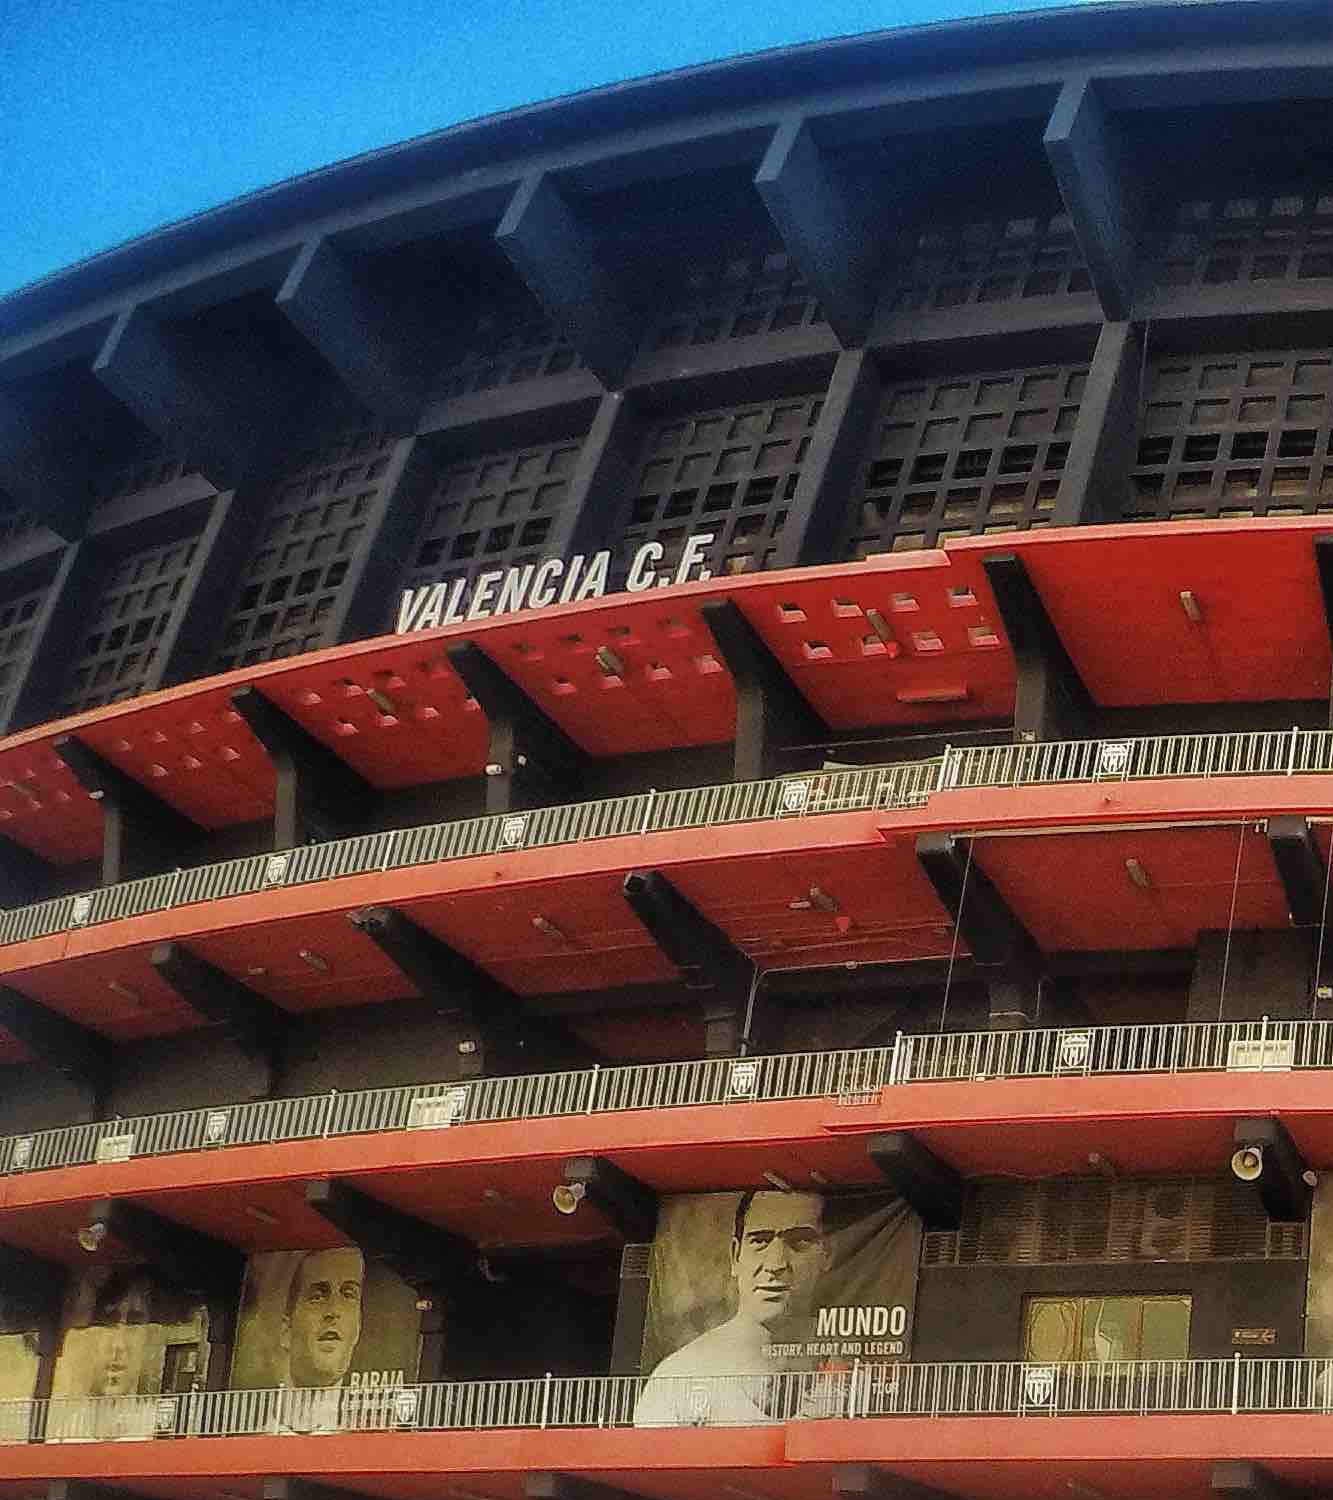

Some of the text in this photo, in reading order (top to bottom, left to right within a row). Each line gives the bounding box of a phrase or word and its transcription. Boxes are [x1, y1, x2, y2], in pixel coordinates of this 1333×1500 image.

[394, 533, 716, 635] VALENCIA C.F.
[816, 1306, 907, 1337] MUNDO
[806, 1341, 838, 1357] HEART
[840, 1341, 862, 1356] AND
[864, 1340, 904, 1357] LEGEND
